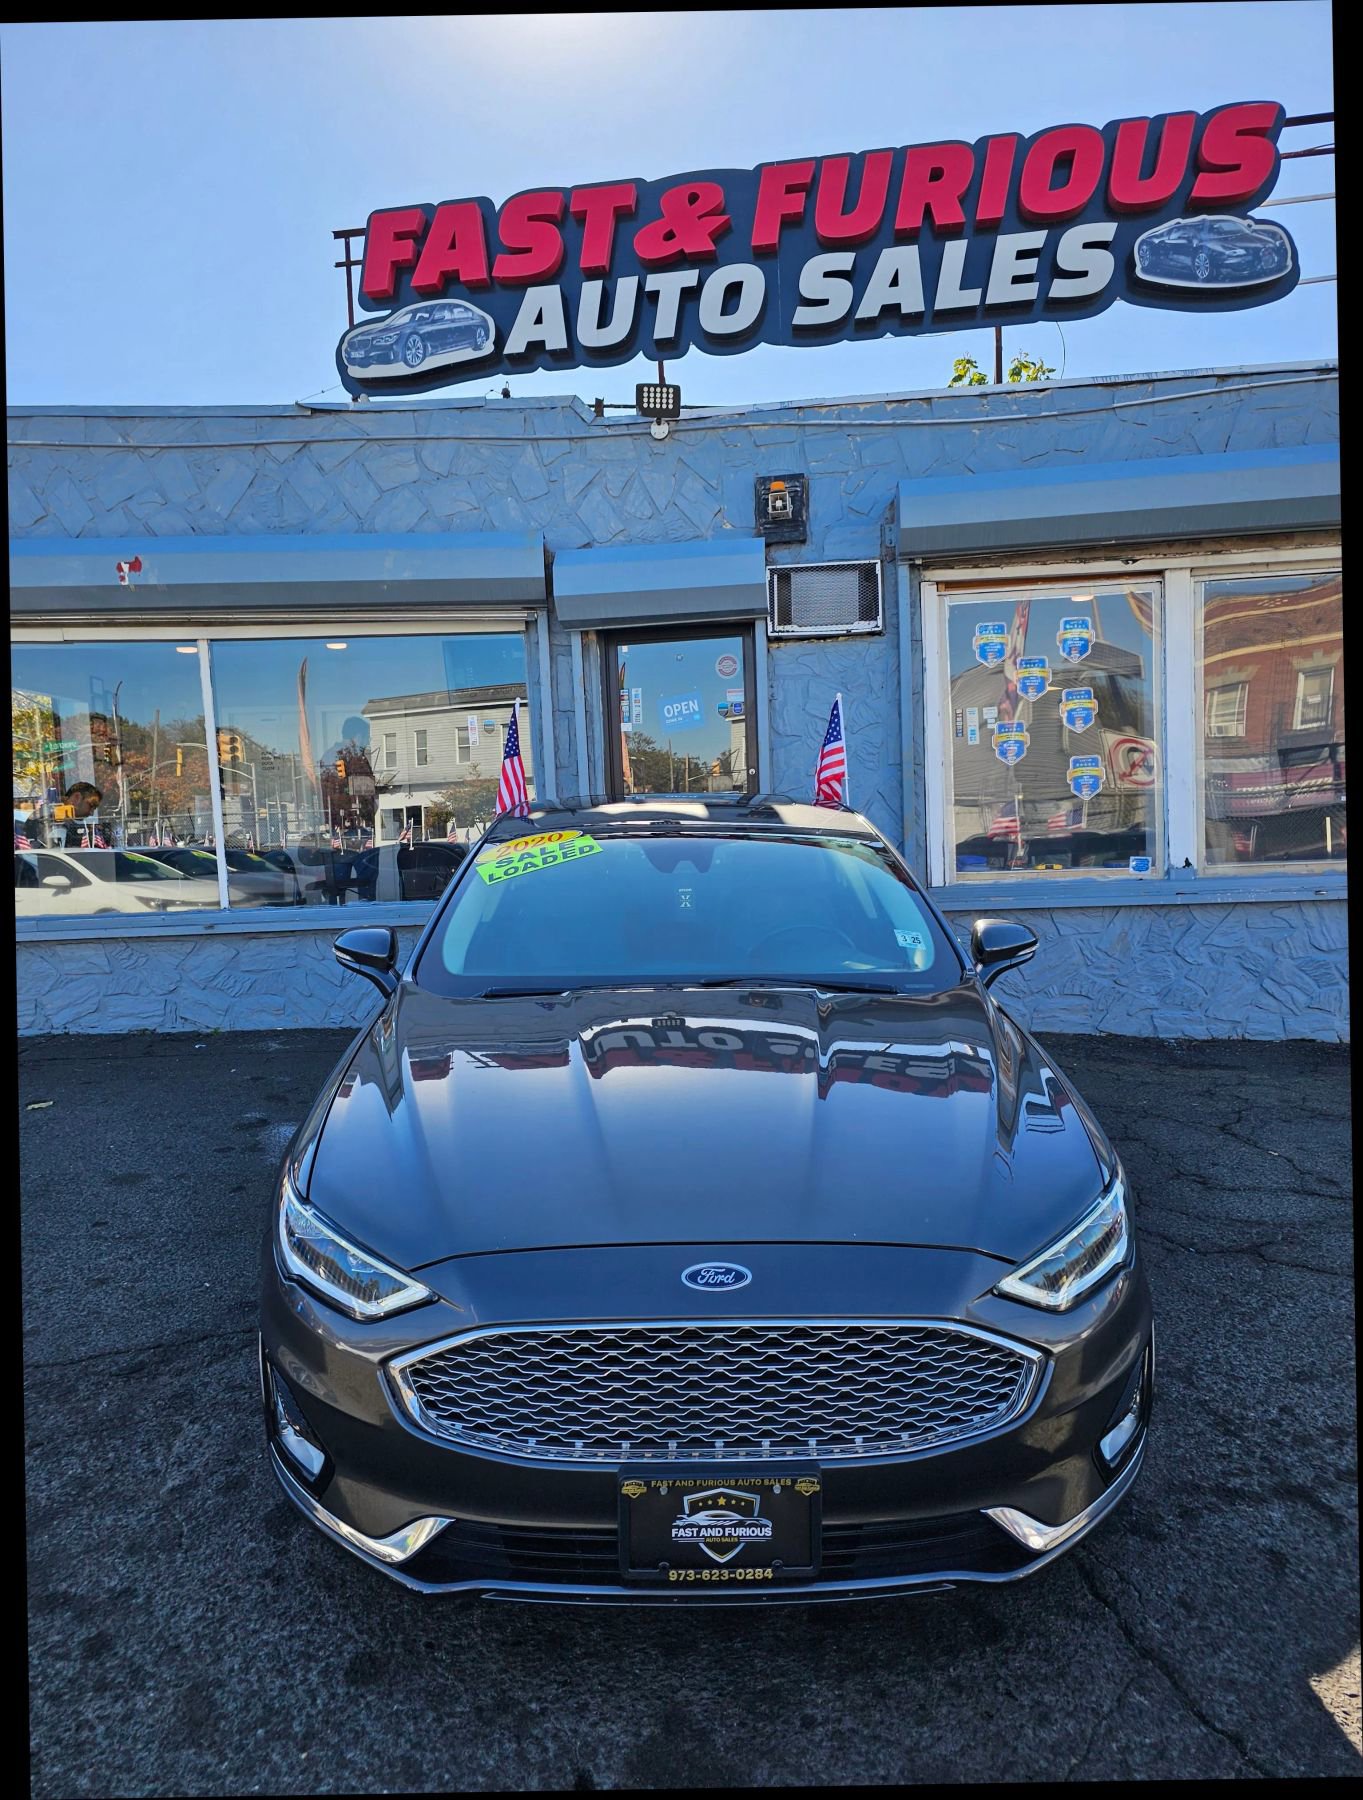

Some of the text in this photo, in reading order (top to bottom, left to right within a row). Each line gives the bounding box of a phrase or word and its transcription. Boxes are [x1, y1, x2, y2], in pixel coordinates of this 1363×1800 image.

[363, 102, 1282, 300] FAST & FURIOUS
[503, 222, 1118, 356] AUTO SALES
[664, 700, 699, 717] OPEN
[497, 832, 563, 858] 2020
[488, 844, 595, 882] LOADED
[495, 840, 575, 869] SALE
[911, 936, 921, 944] 25
[697, 1268, 736, 1284] Ford
[651, 1480, 674, 1488] FAST
[696, 1479, 736, 1487] FURIOUS
[763, 1478, 792, 1486] SALES
[671, 1526, 773, 1538] FAST AND FURIOUS
[668, 1568, 773, 1581] 973-623-0284
